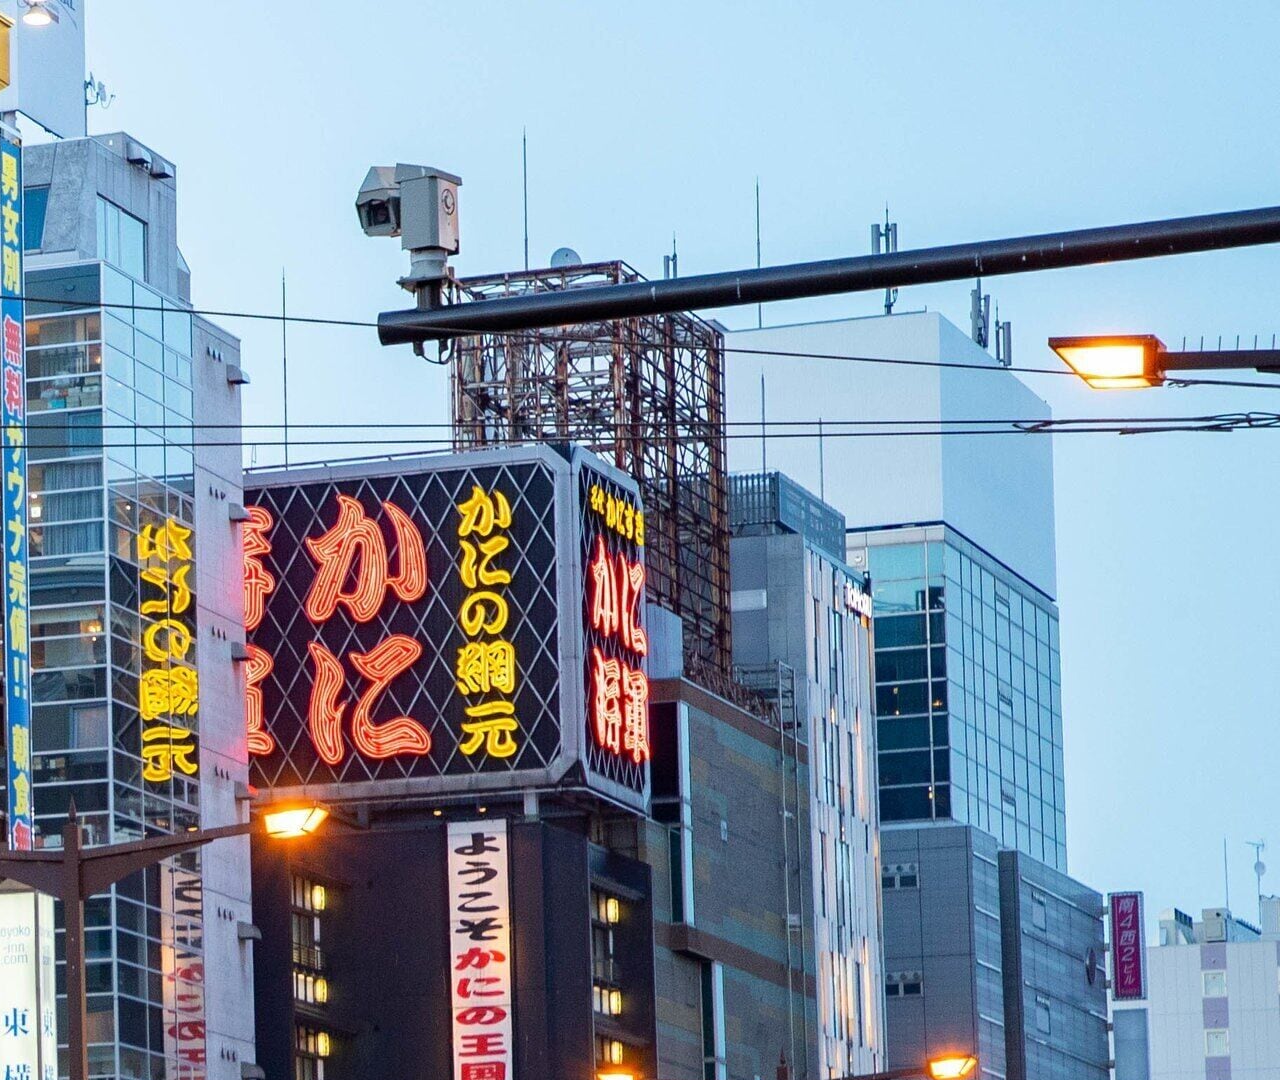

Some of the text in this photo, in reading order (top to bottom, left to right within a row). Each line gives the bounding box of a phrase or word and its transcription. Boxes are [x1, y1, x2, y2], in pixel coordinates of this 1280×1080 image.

[1, 150, 21, 296] 男女別
[606, 492, 645, 546] かにすき
[306, 493, 432, 765] かに
[456, 484, 518, 759] かにの網元
[592, 534, 648, 657] かに
[0, 952, 29, 965] .com
[1117, 895, 1136, 985] 南4西2ビル
